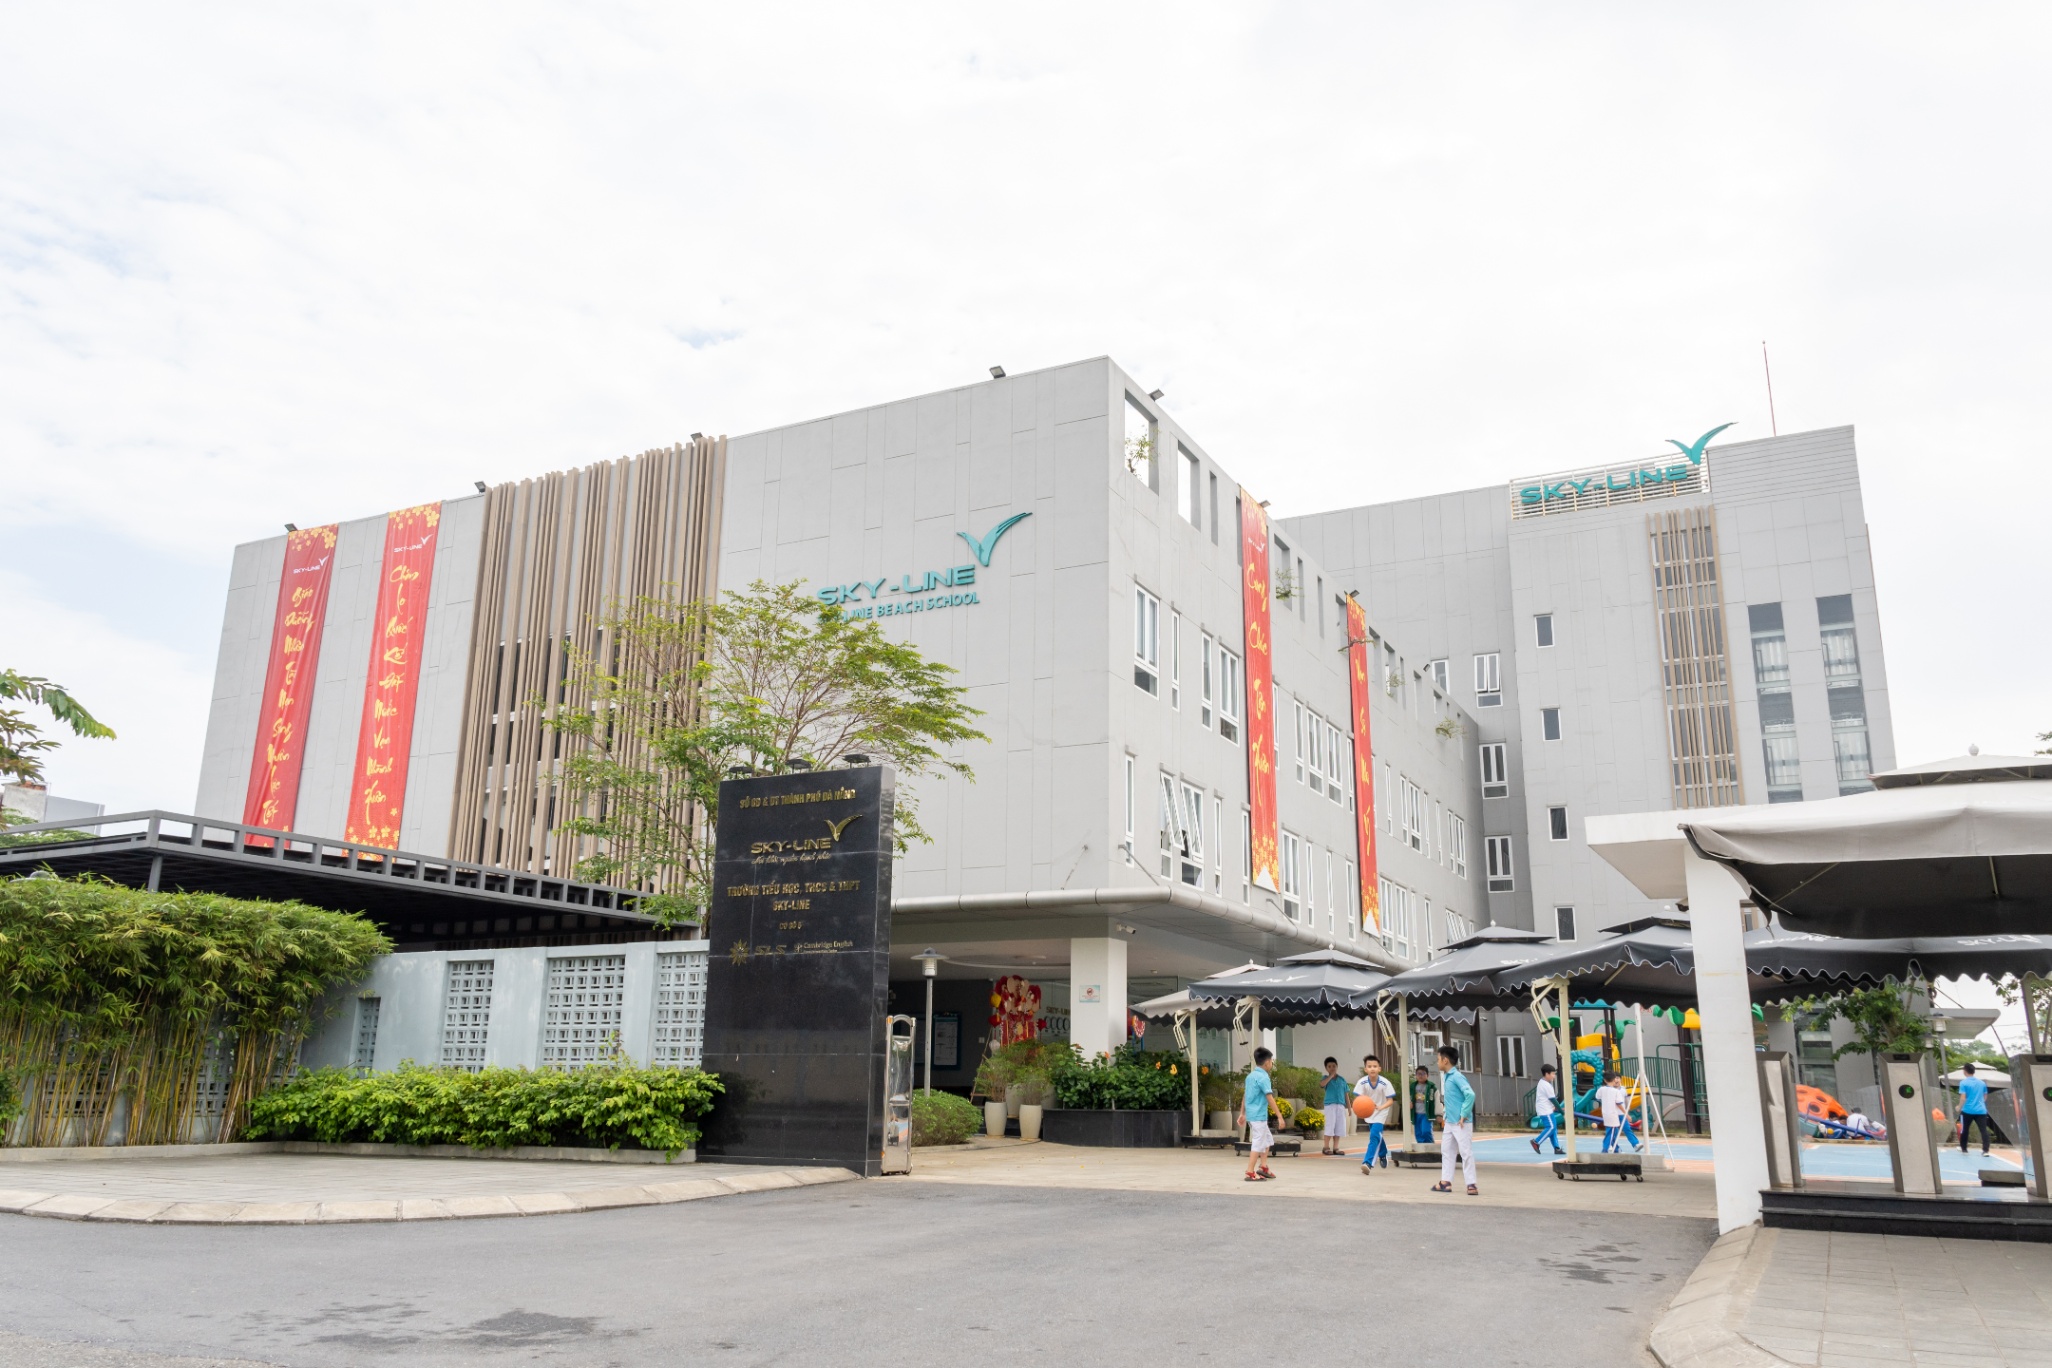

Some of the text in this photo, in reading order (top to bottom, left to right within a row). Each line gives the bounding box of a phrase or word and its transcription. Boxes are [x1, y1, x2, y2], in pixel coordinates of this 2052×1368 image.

[1520, 464, 1688, 504] SKY-LINE
[817, 564, 976, 605] SKY-LINE
[877, 599, 924, 617] BEACH
[926, 592, 980, 610] SCHOOL
[751, 838, 831, 854] SKY-LINE
[804, 881, 827, 893] THCS
[829, 881, 836, 892] &
[772, 899, 810, 911] SKY-LINE
